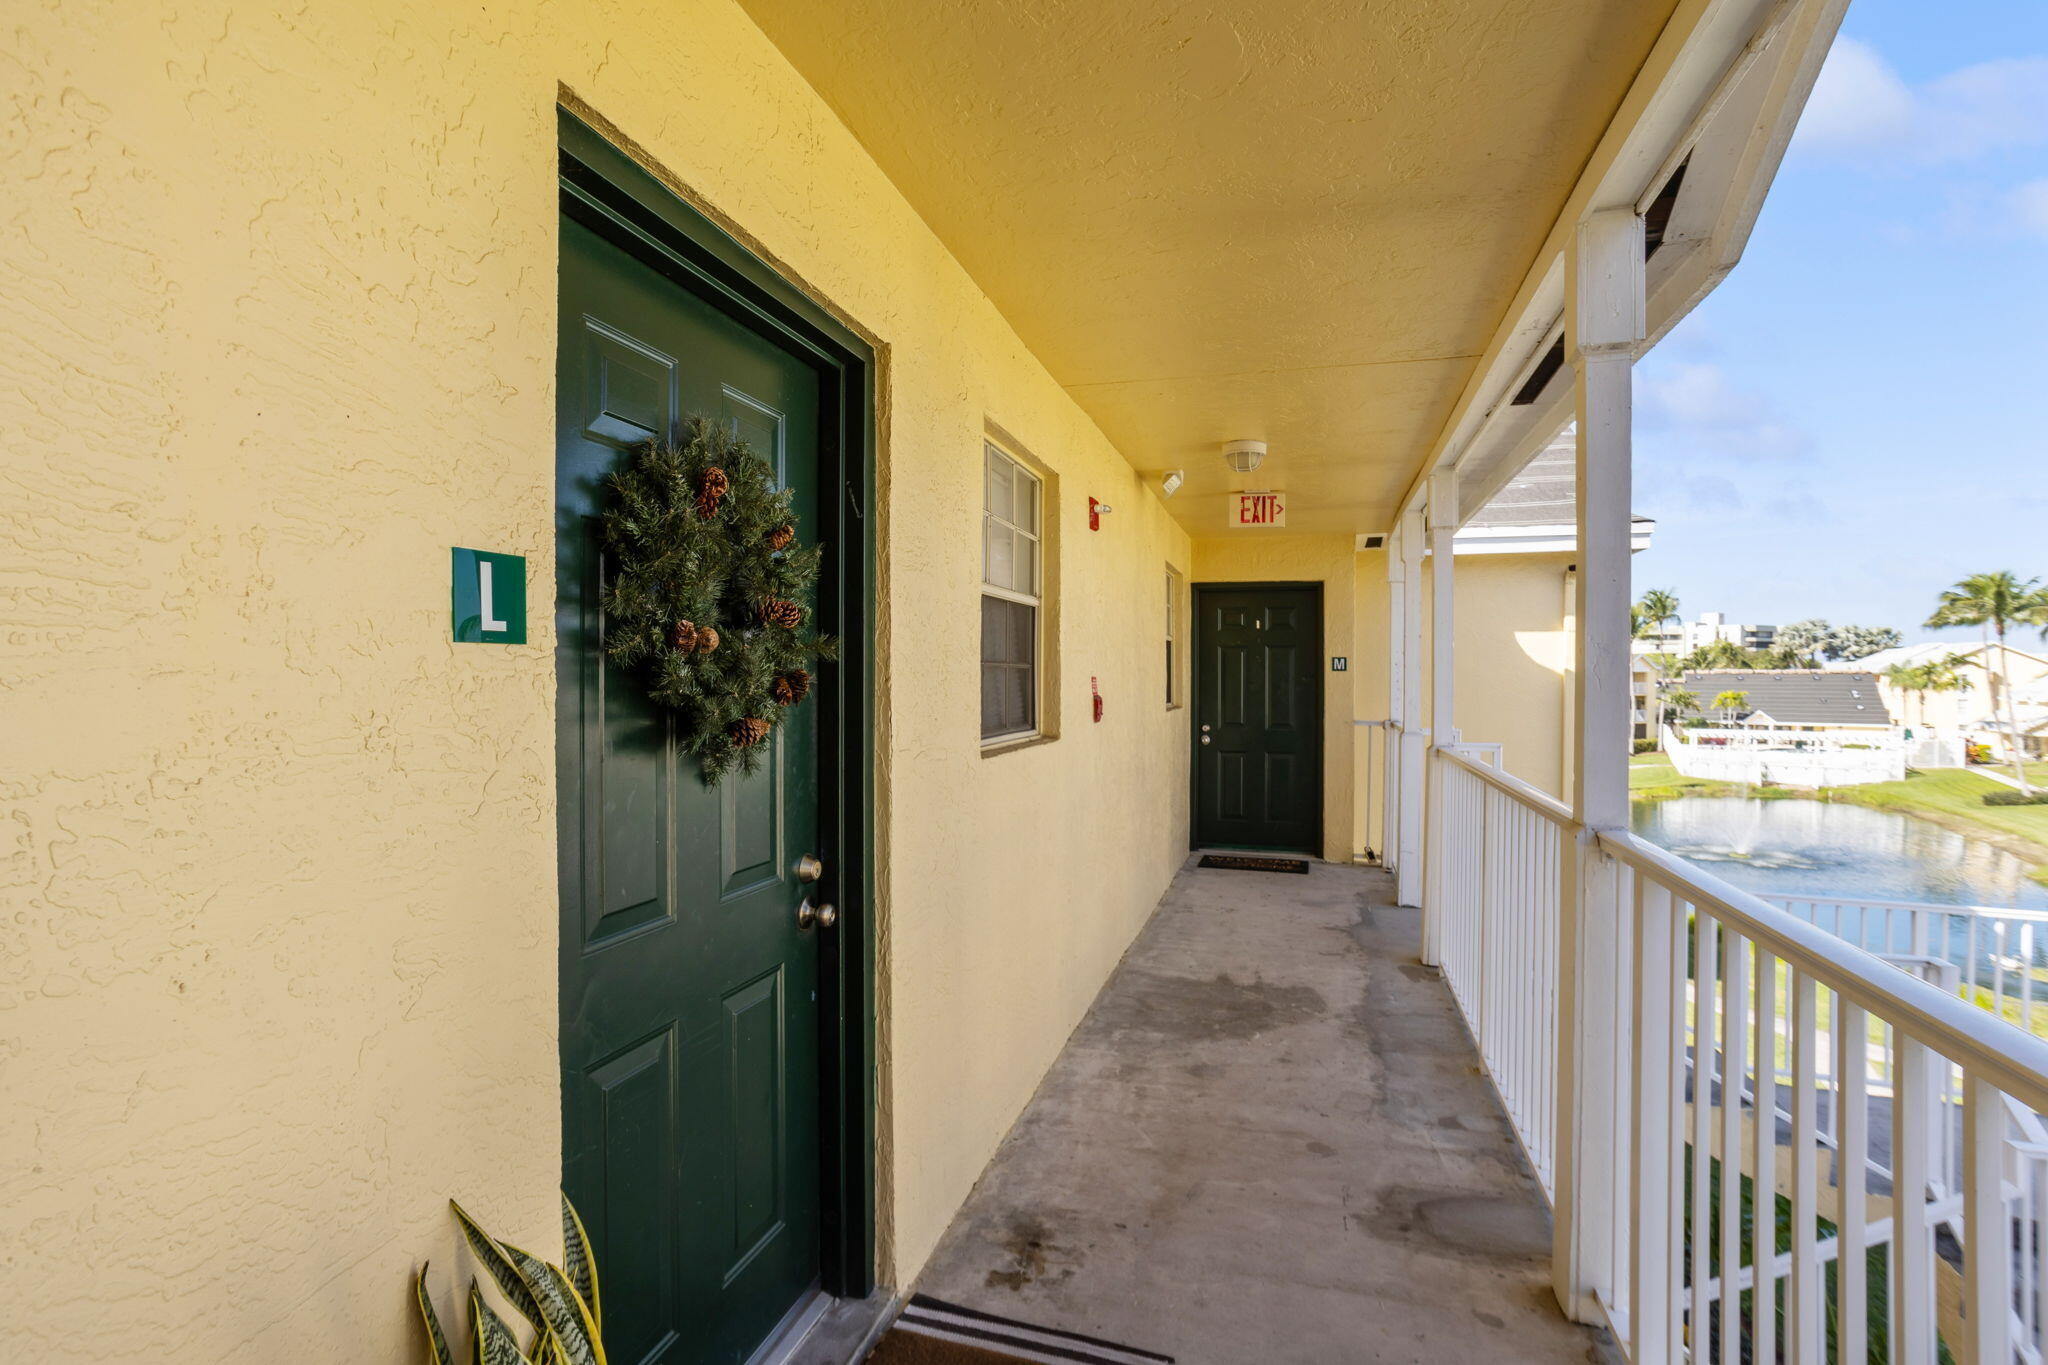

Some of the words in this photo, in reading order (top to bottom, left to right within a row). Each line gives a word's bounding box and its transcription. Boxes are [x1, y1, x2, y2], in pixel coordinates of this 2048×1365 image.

[1240, 495, 1278, 524] EXIT
[479, 560, 507, 632] L
[1333, 658, 1346, 671] M
